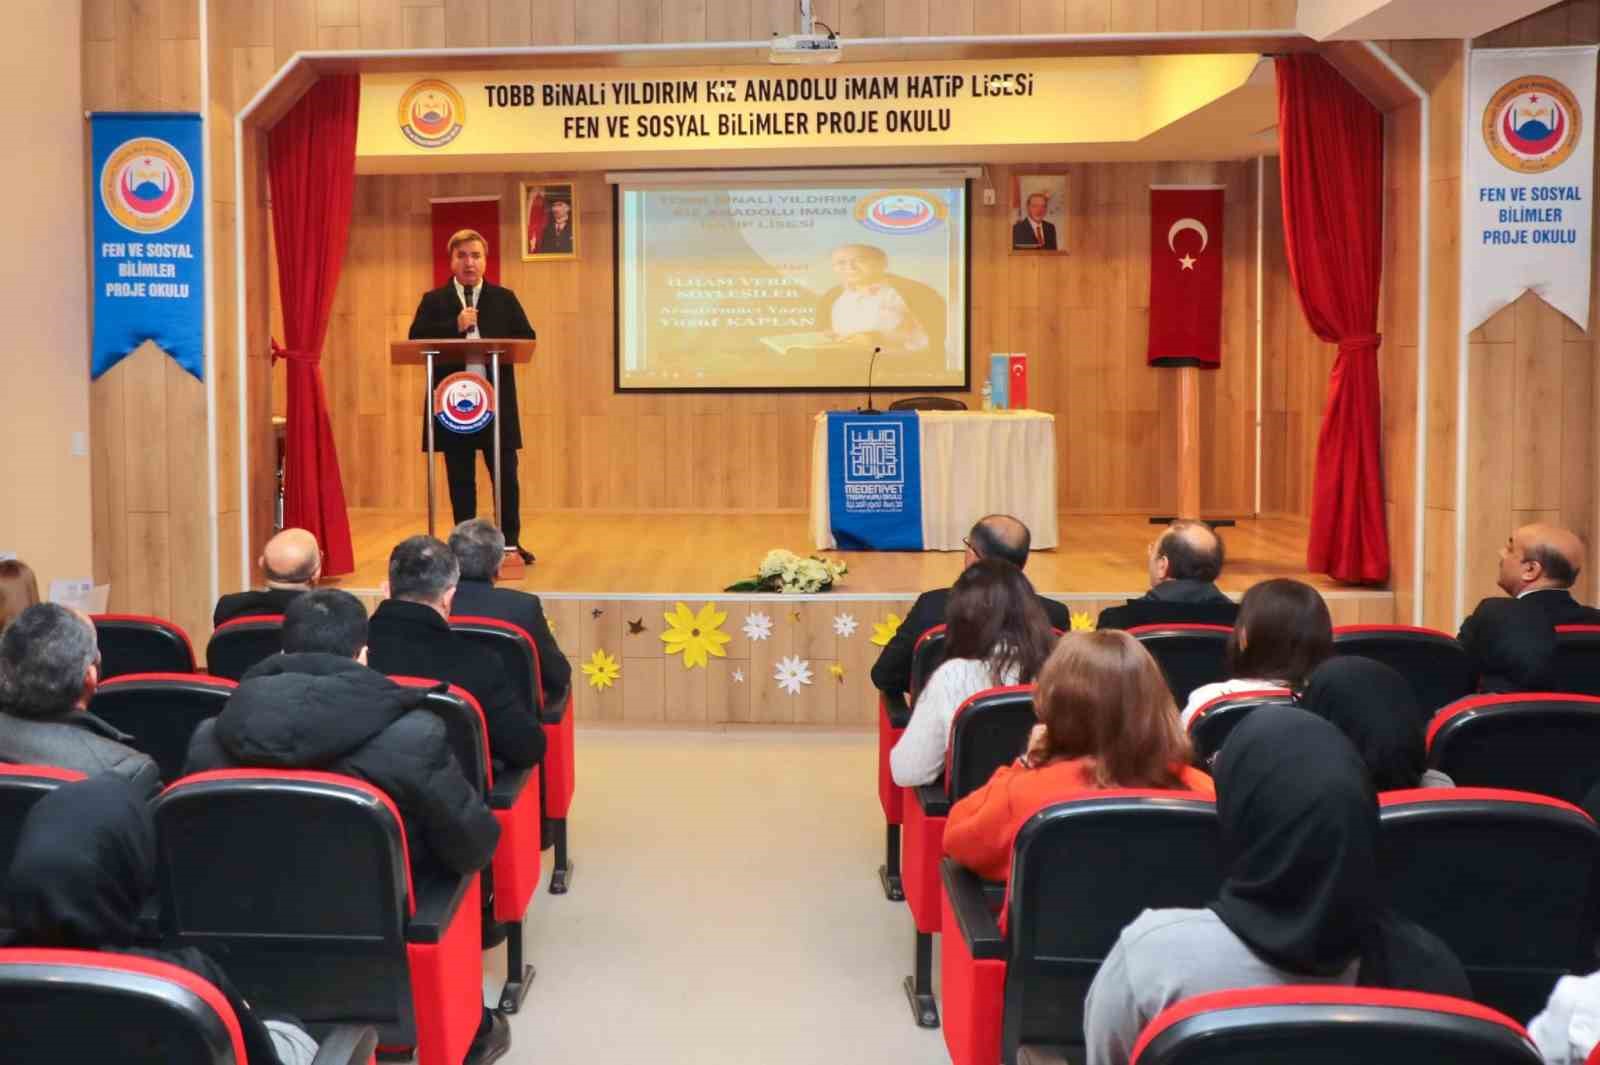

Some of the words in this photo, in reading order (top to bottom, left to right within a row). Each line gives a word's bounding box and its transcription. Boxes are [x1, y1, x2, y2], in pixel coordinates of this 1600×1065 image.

[484, 84, 535, 107] TOBB
[612, 80, 698, 104] YILDIRIM
[744, 78, 837, 102] ANADOLU
[564, 116, 599, 139] FEN
[606, 115, 630, 138] VE
[637, 113, 711, 137] SOSYAL
[816, 110, 879, 134] PROJE
[886, 108, 951, 132] OKULU
[1480, 187, 1506, 202] FEN
[1510, 187, 1527, 201] VE
[1531, 186, 1582, 201] SOSYAL
[1482, 229, 1529, 245] PROJE
[1532, 229, 1577, 244] OKULU
[102, 243, 126, 258] FEN
[128, 243, 144, 258] VE
[146, 244, 193, 259] SOSYAL
[106, 282, 146, 298] PROJE
[148, 283, 190, 299] OKULU
